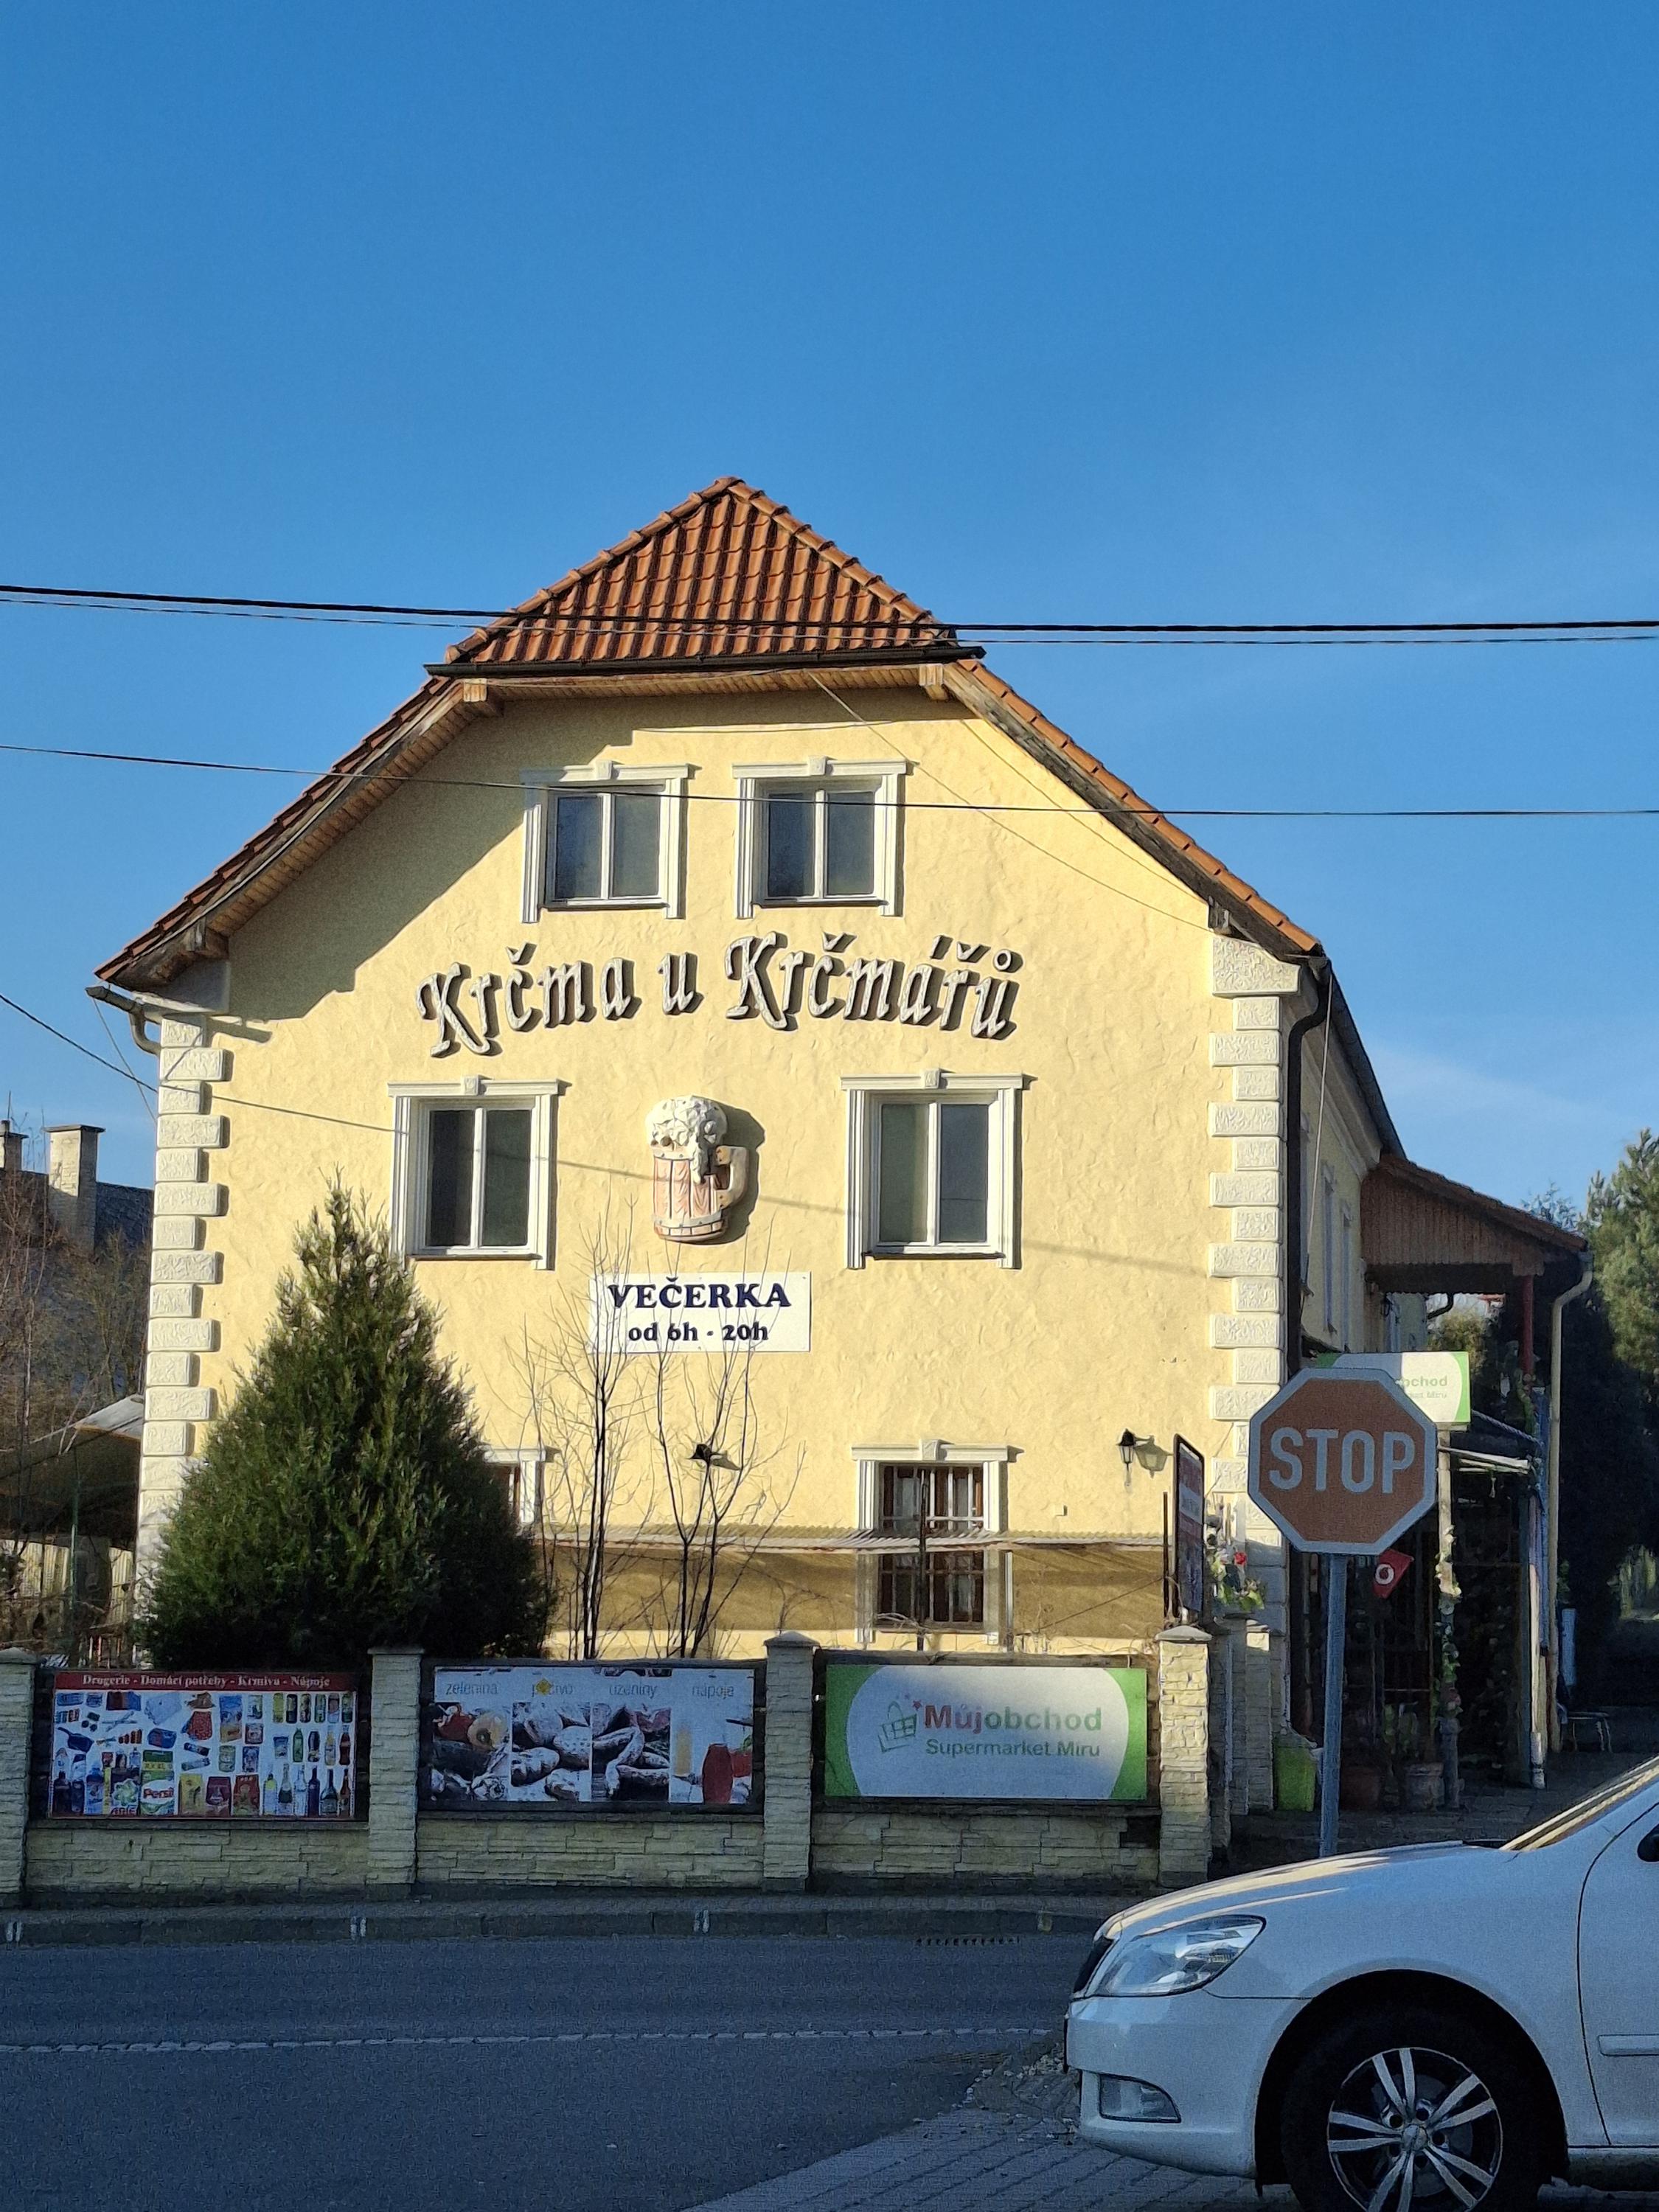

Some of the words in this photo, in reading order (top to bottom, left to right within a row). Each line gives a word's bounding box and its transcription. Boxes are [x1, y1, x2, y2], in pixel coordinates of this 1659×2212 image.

[416, 941, 643, 1058] Krčma
[658, 951, 704, 1015] u
[725, 931, 1023, 1040] Krčmářů
[607, 1276, 792, 1308] VEČERKA
[628, 1322, 658, 1340] od
[667, 1322, 698, 1341] 6h
[722, 1322, 769, 1341] 20h
[1400, 1375, 1448, 1388] bchod
[1268, 1427, 1415, 1494] STOP
[83, 1674, 130, 1687] Drogerie
[184, 1674, 226, 1688] potřeby
[291, 1675, 330, 1688] Nápoje
[445, 1681, 498, 1695] zelenina
[609, 1683, 658, 1698] uzeniny
[692, 1682, 734, 1700] nápoje
[924, 1703, 1102, 1734] Můjobchod
[925, 1739, 1054, 1758] Supermarket
